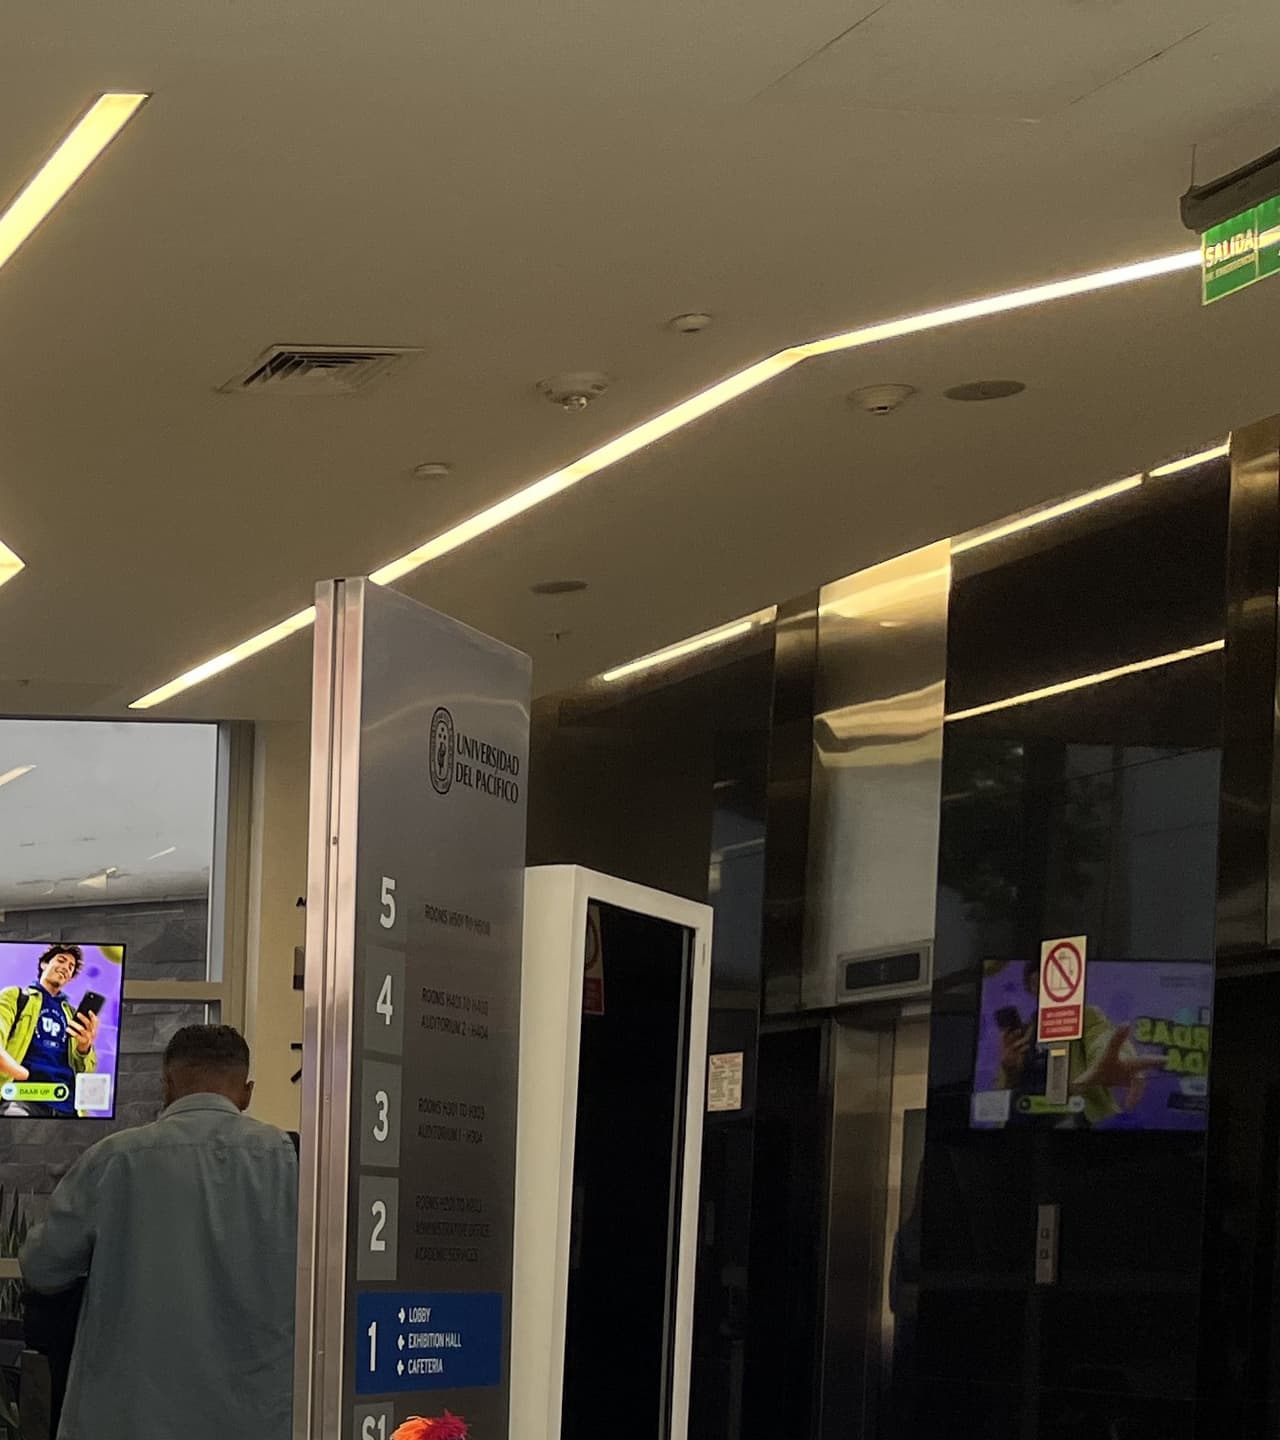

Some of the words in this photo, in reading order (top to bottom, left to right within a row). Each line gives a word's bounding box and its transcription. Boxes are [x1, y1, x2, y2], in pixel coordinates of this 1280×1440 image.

[1205, 228, 1254, 268] SALIDA
[456, 732, 519, 776] UNIVERSIDAD
[456, 761, 472, 787] DEL
[379, 876, 397, 929] 5
[376, 974, 394, 1026] 4
[42, 1016, 61, 1037] UP
[372, 1090, 389, 1142] 3
[369, 1200, 386, 1252] 2
[409, 1307, 431, 1323] LOBBY
[367, 1321, 378, 1372] 1
[408, 1333, 445, 1349] EXHIBITION
[445, 1332, 462, 1348] HALL
[408, 1358, 444, 1375] CAFETERIA
